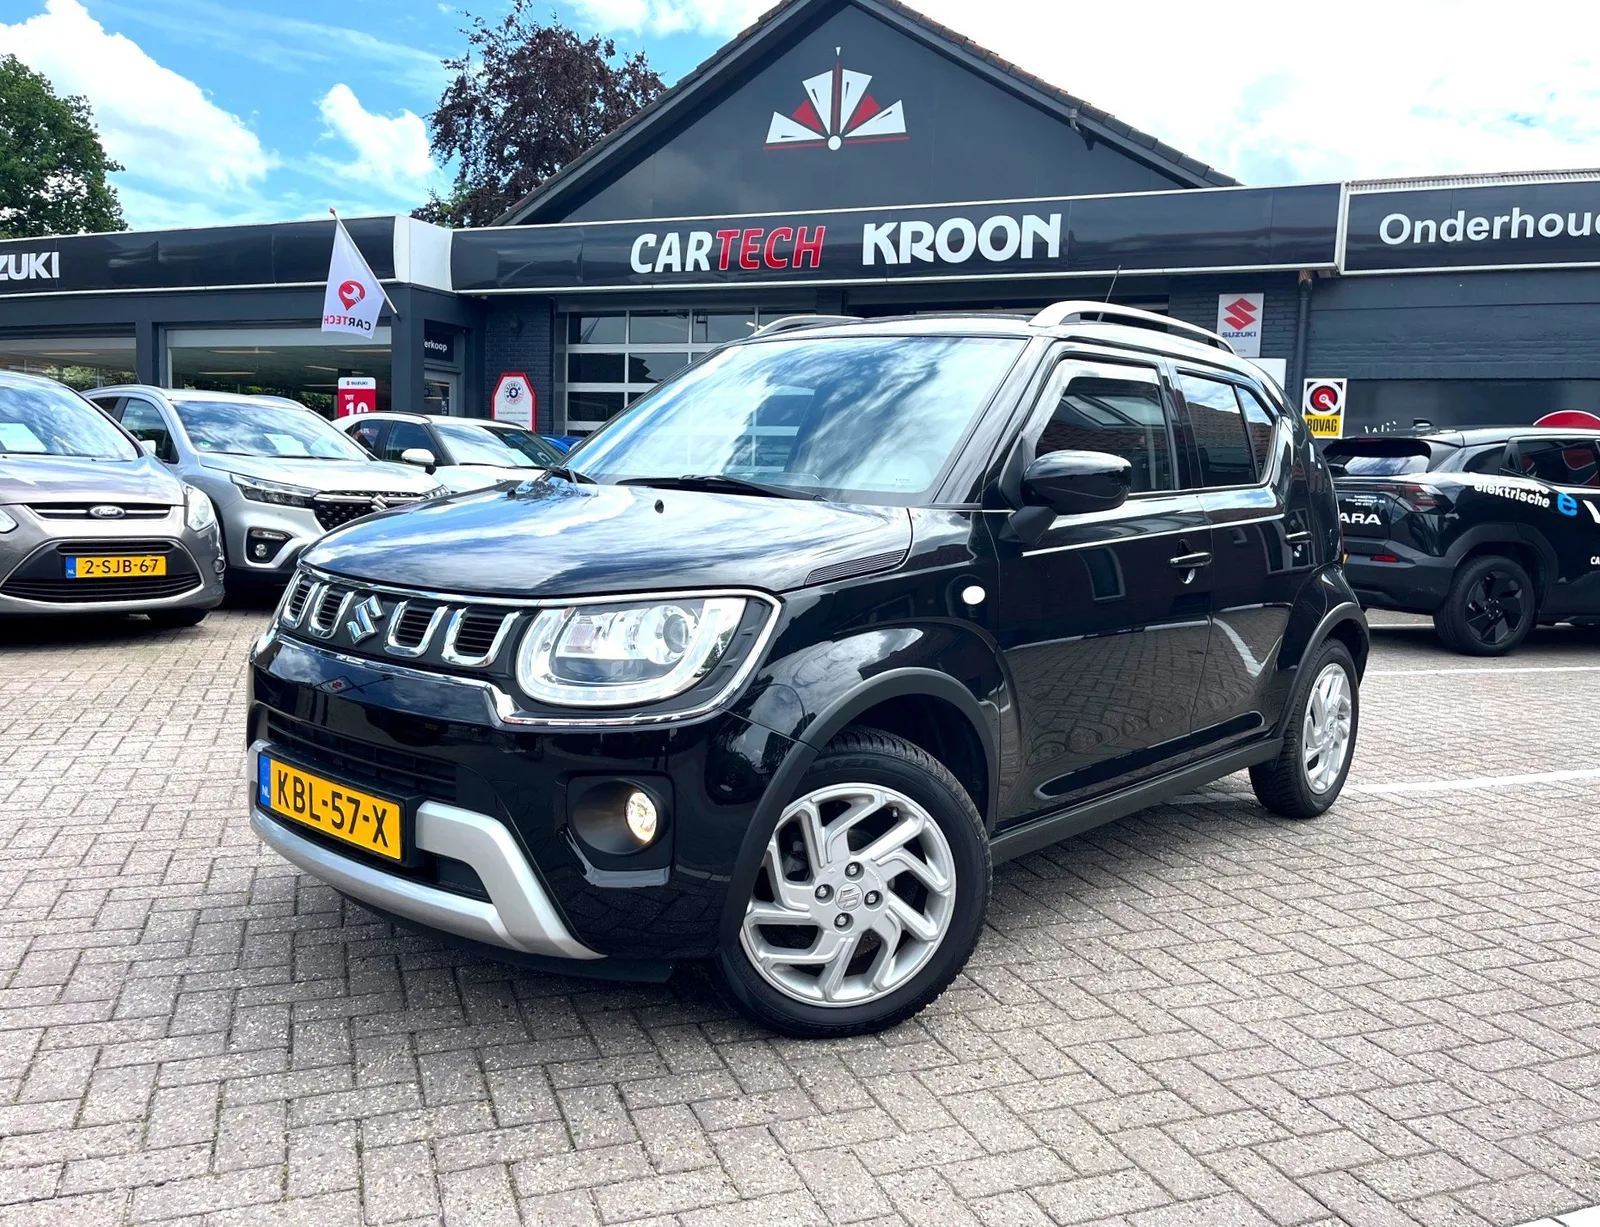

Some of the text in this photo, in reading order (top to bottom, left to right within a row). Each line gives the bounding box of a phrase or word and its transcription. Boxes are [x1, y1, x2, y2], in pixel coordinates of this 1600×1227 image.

[1379, 207, 1600, 245] Onderhou
[630, 213, 1062, 273] CARTECH KROON
[424, 340, 448, 352] erkoop
[1307, 419, 1338, 432] BOVAG
[1473, 484, 1550, 508] elektrische
[84, 559, 159, 574] 2-SJB-67
[261, 769, 389, 848] NL KBL-57-X
